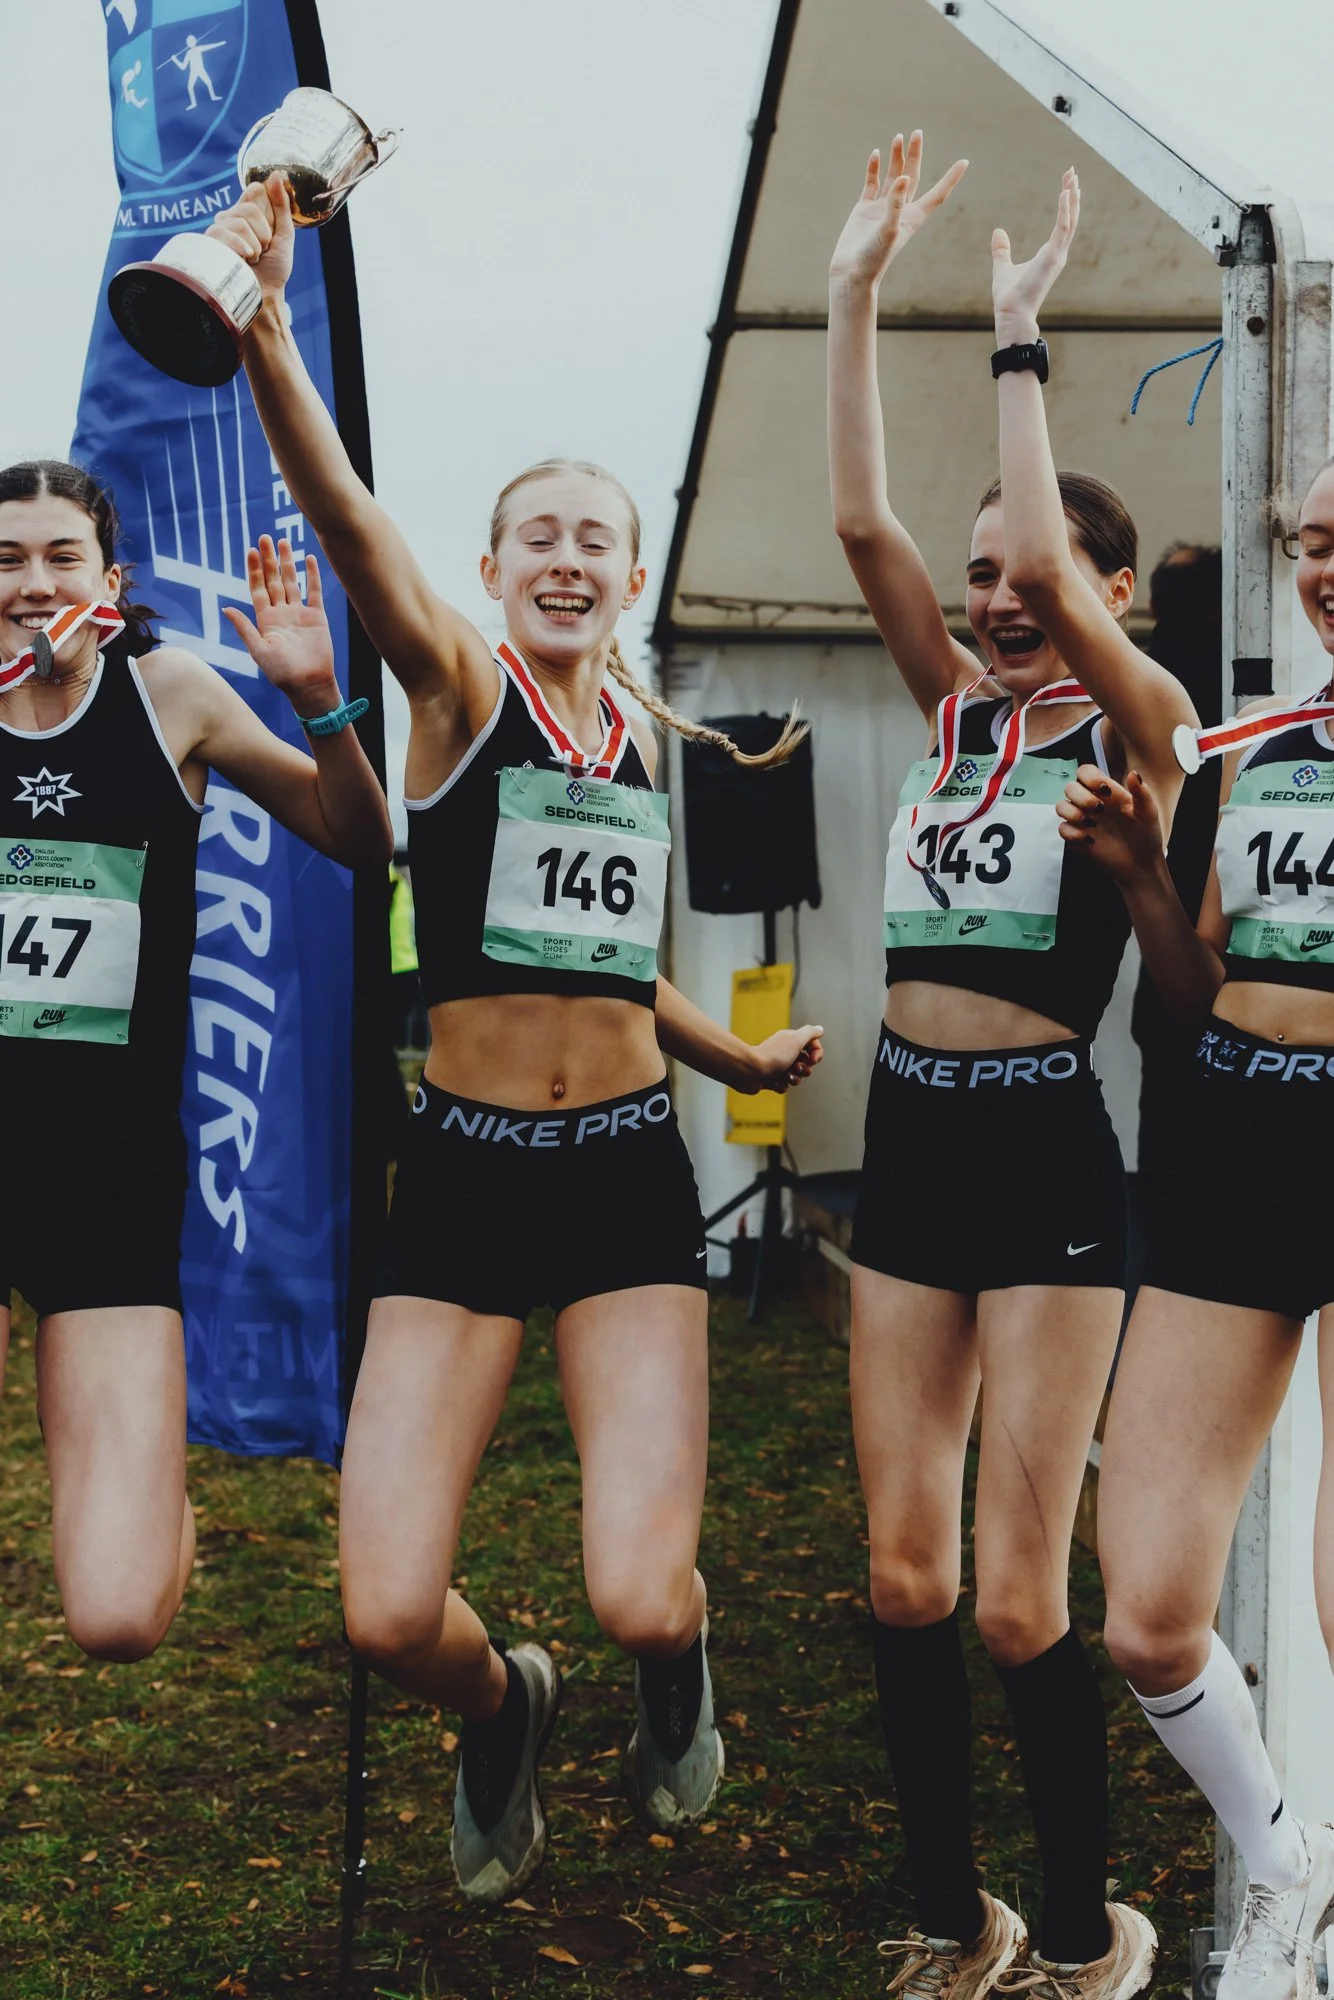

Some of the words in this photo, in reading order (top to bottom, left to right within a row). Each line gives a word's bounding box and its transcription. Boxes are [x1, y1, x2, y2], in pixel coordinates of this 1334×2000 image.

[139, 185, 231, 224] TIMEANT
[35, 785, 56, 796] 1887
[545, 805, 636, 829] SEDGEFIELD
[917, 822, 1016, 884] 143
[537, 847, 637, 915] 146
[153, 552, 276, 1255] HRRIERS
[925, 915, 947, 923] SPORTS
[964, 915, 988, 926] RUN
[542, 945, 568, 953] SHOES
[543, 937, 573, 947] SPORTS
[597, 943, 618, 955] RUN
[40, 1009, 67, 1021] RUN
[879, 1038, 960, 1088] NIKE
[968, 1051, 1078, 1088] PRO
[1244, 1049, 1334, 1081] PR
[441, 1105, 565, 1148] NIKE
[575, 1092, 670, 1145] PRO
